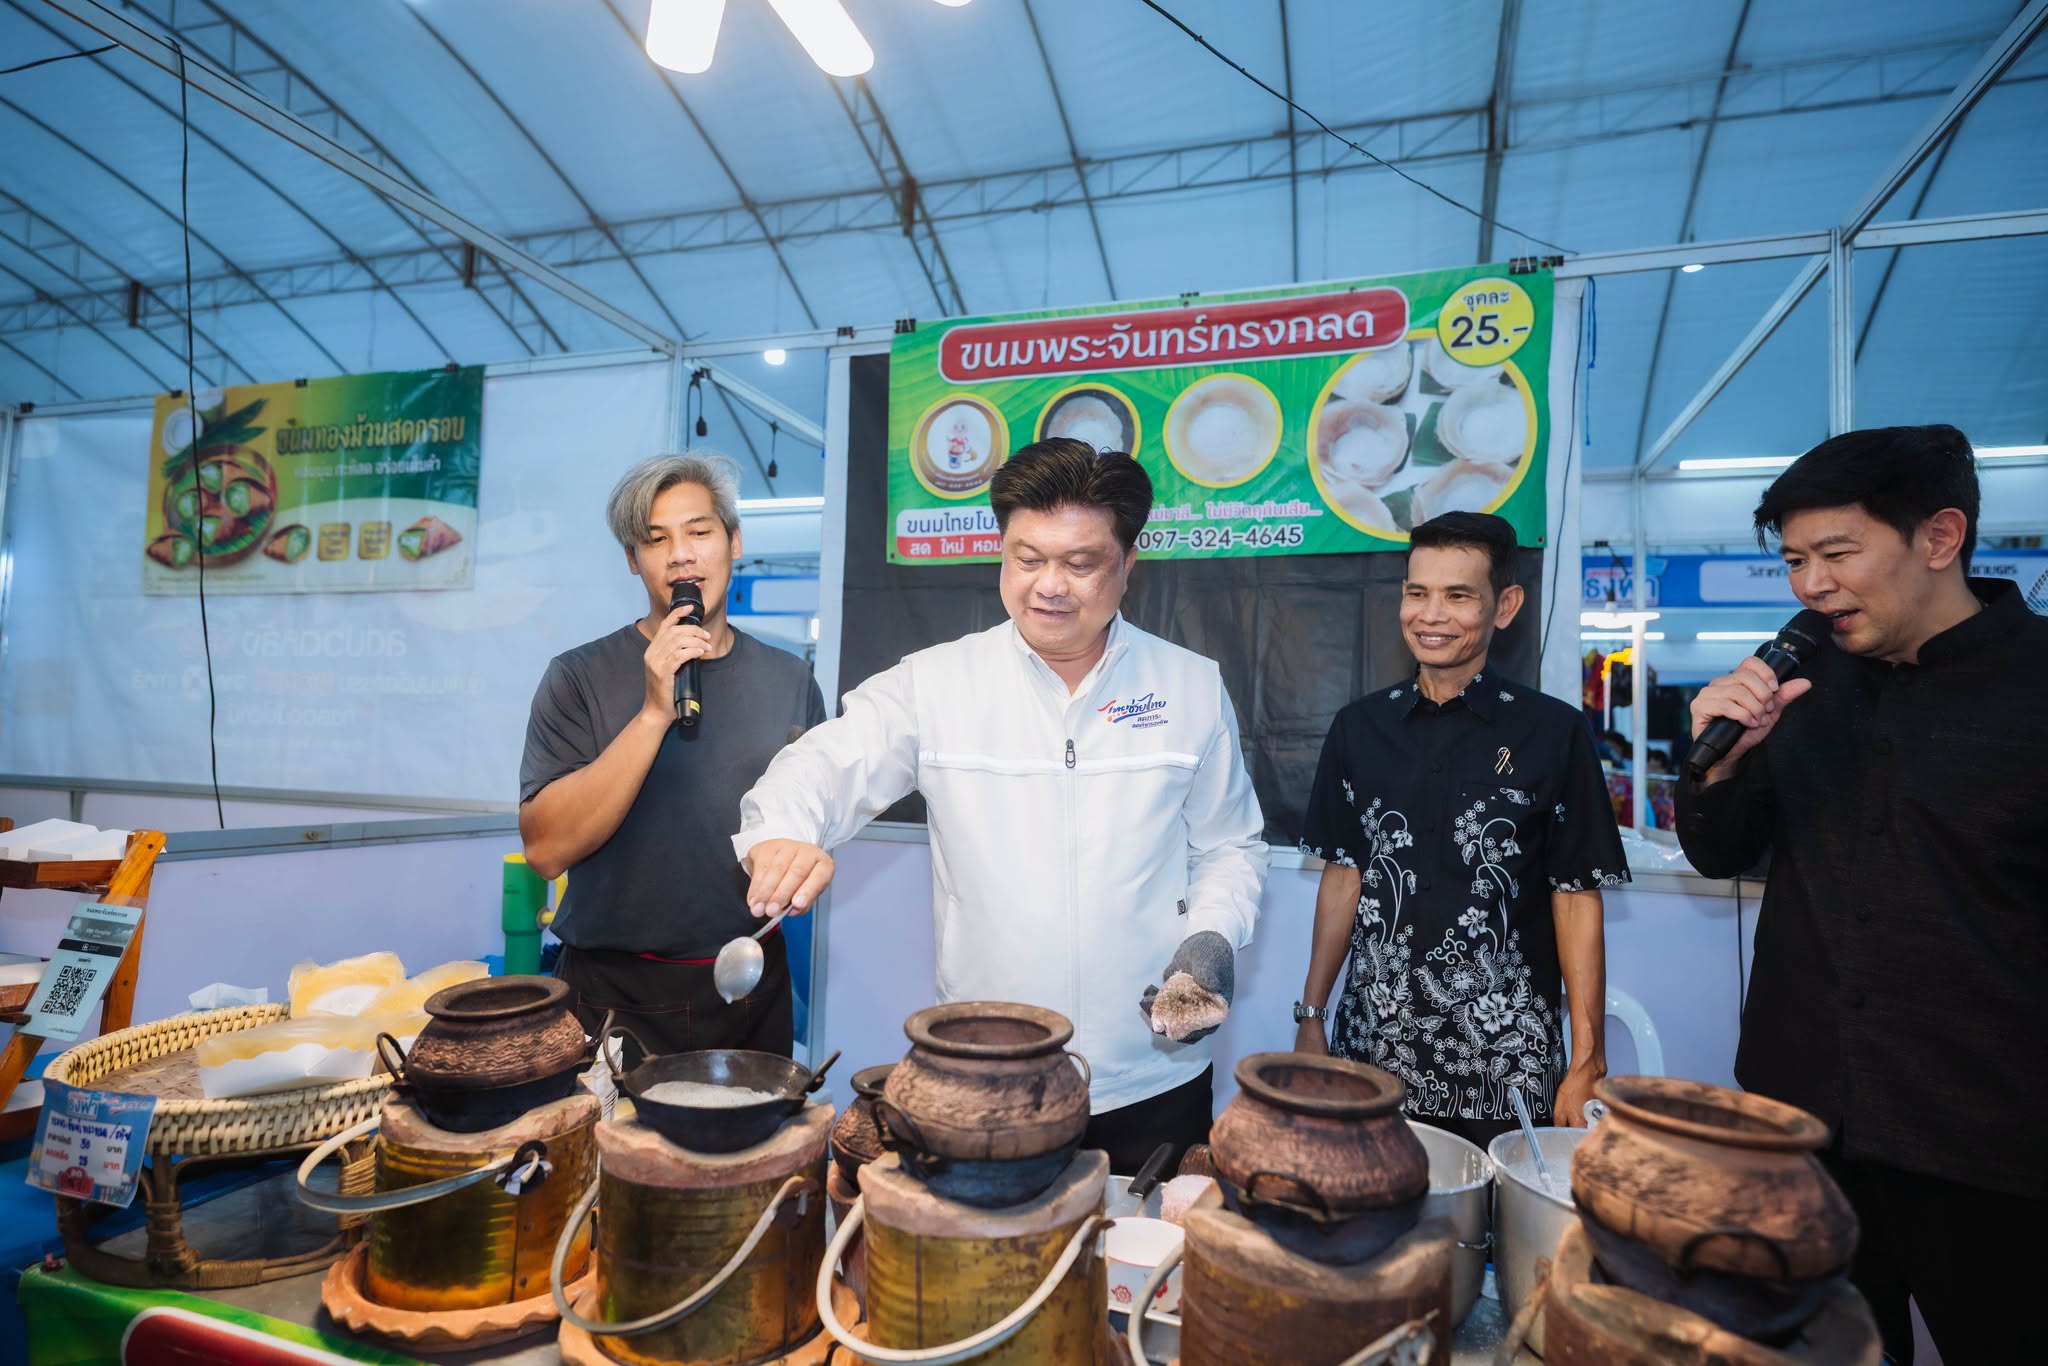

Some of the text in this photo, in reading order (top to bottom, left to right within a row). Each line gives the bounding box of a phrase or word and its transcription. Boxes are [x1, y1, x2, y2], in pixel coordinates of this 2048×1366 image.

[960, 309, 1376, 371] ขนมพระจันทร์ทรงกลด
[1451, 313, 1529, 348] 25.-
[907, 510, 1000, 533] ขนมไทยโบ
[909, 542, 932, 556] สด
[940, 536, 966, 555] ใหม่
[1138, 525, 1303, 550] 097-324-4645
